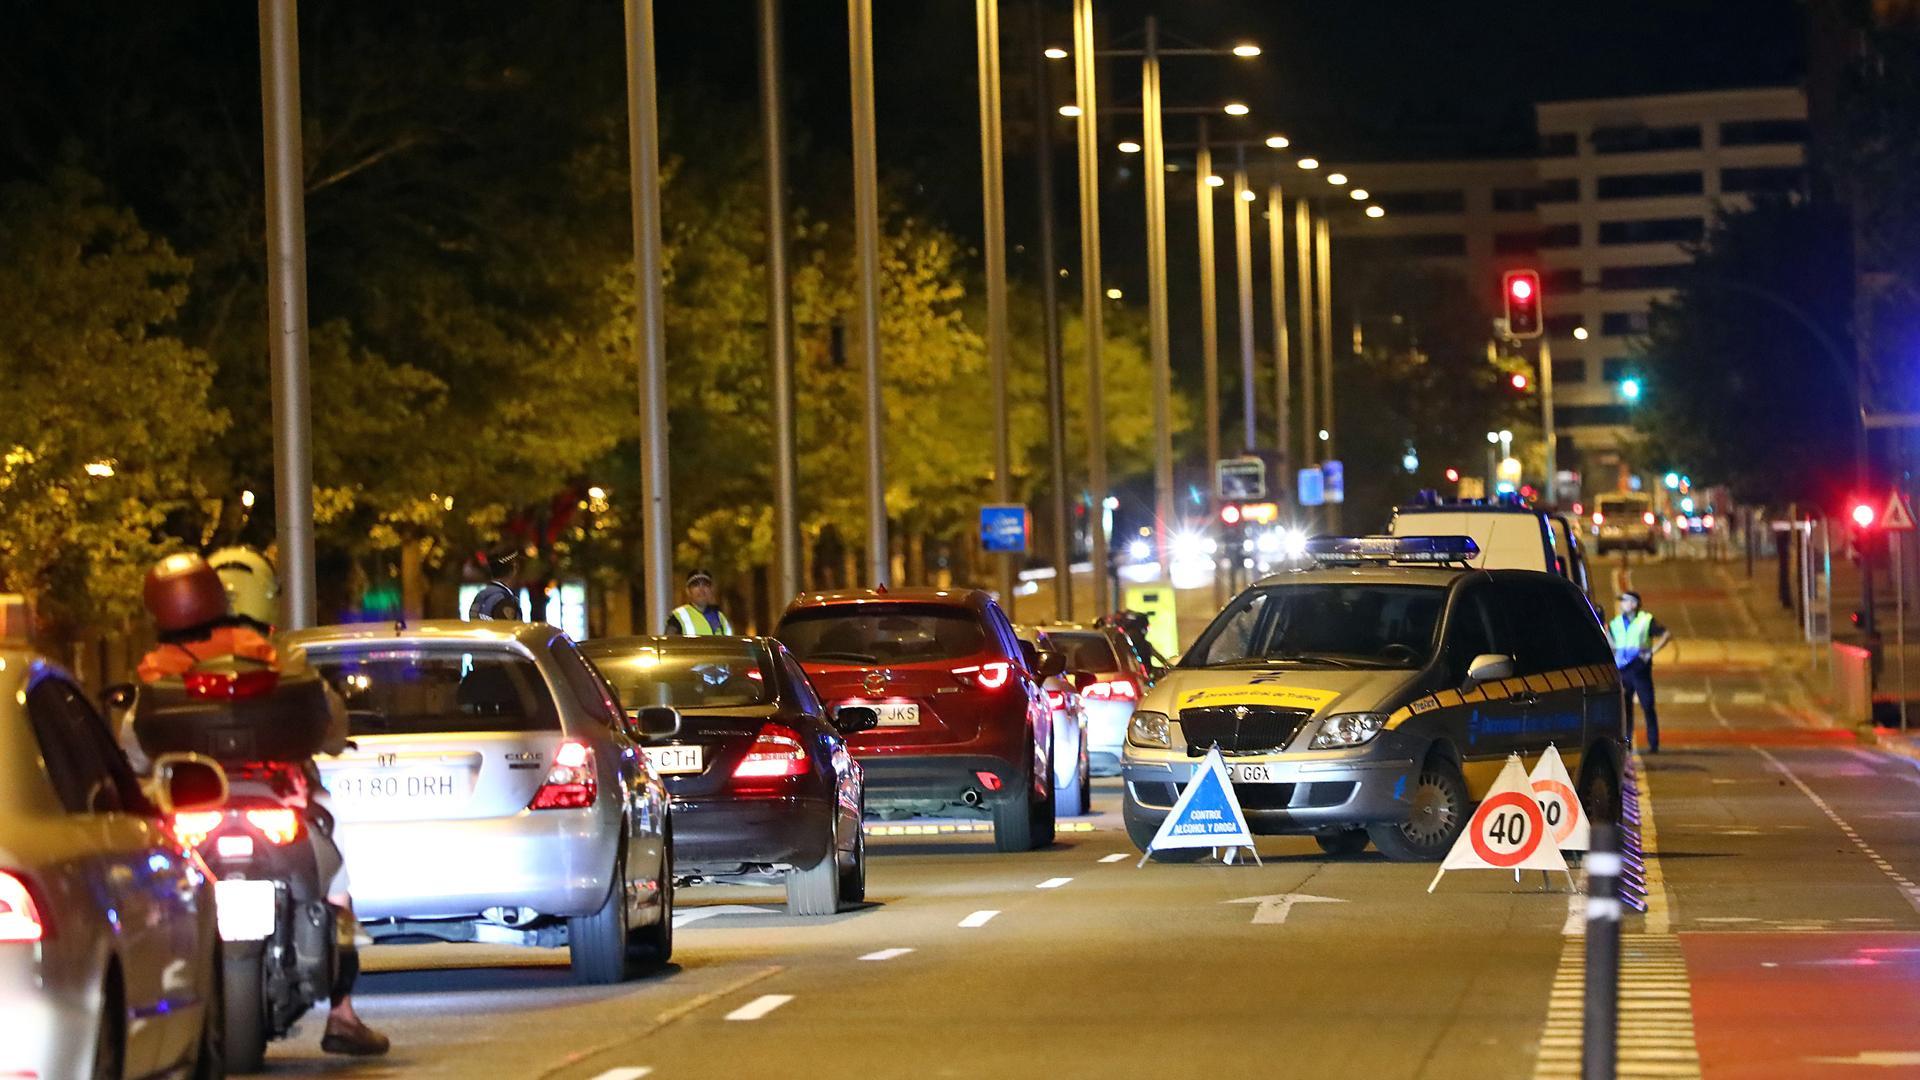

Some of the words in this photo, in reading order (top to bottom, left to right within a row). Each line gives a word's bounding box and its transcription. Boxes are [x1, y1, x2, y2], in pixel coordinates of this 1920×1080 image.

[888, 707, 915, 720] JKS
[661, 750, 696, 767] CTH
[1243, 765, 1270, 781] GGX
[339, 777, 398, 797] 9180
[407, 776, 452, 797] DRH
[1190, 809, 1223, 821] CONTROL
[1174, 823, 1207, 834] ALCOHOL
[1207, 823, 1214, 833] Y
[1214, 822, 1237, 833] DROGA
[1489, 812, 1525, 845] 40
